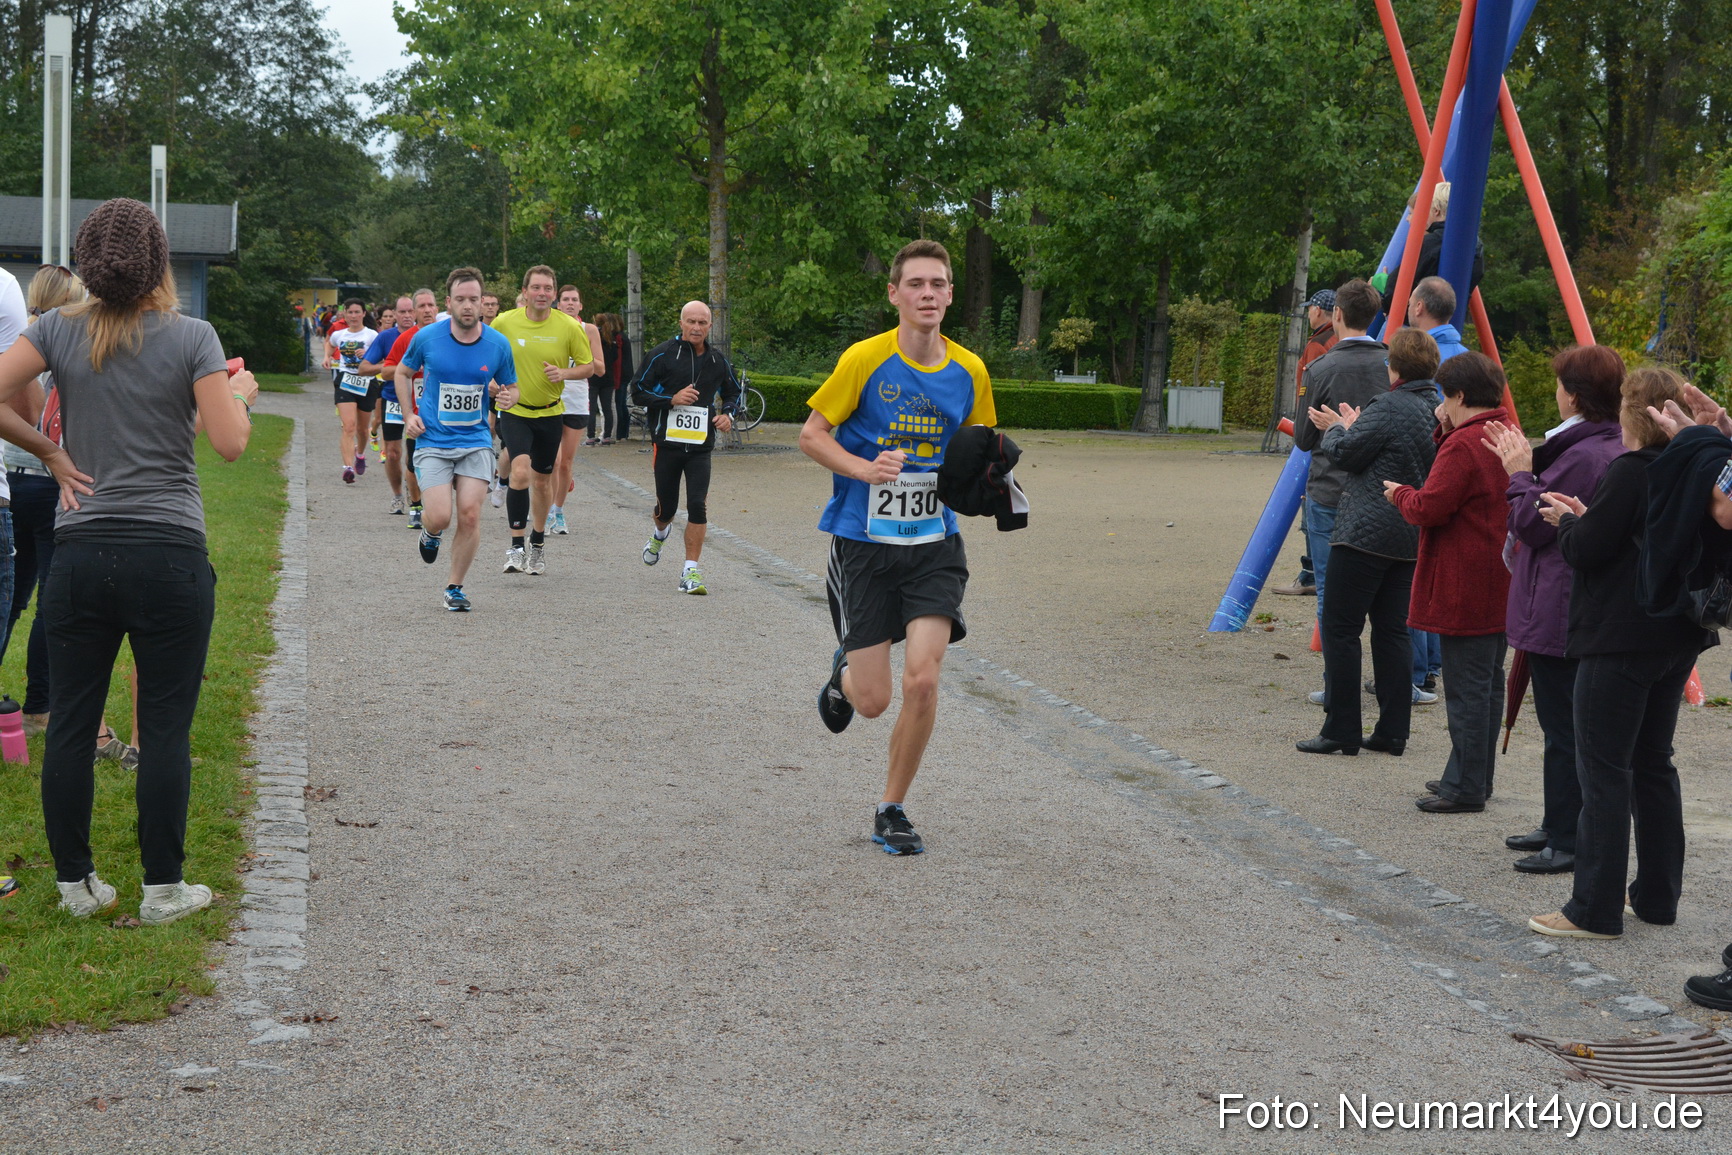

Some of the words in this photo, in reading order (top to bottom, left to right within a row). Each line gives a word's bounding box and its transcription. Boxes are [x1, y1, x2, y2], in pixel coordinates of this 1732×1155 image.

[346, 375, 367, 387] 2061
[443, 394, 479, 411] 3386
[676, 414, 700, 429] 630
[900, 480, 936, 488] Neumarkt
[877, 489, 937, 517] 2130
[898, 524, 918, 535] Luis
